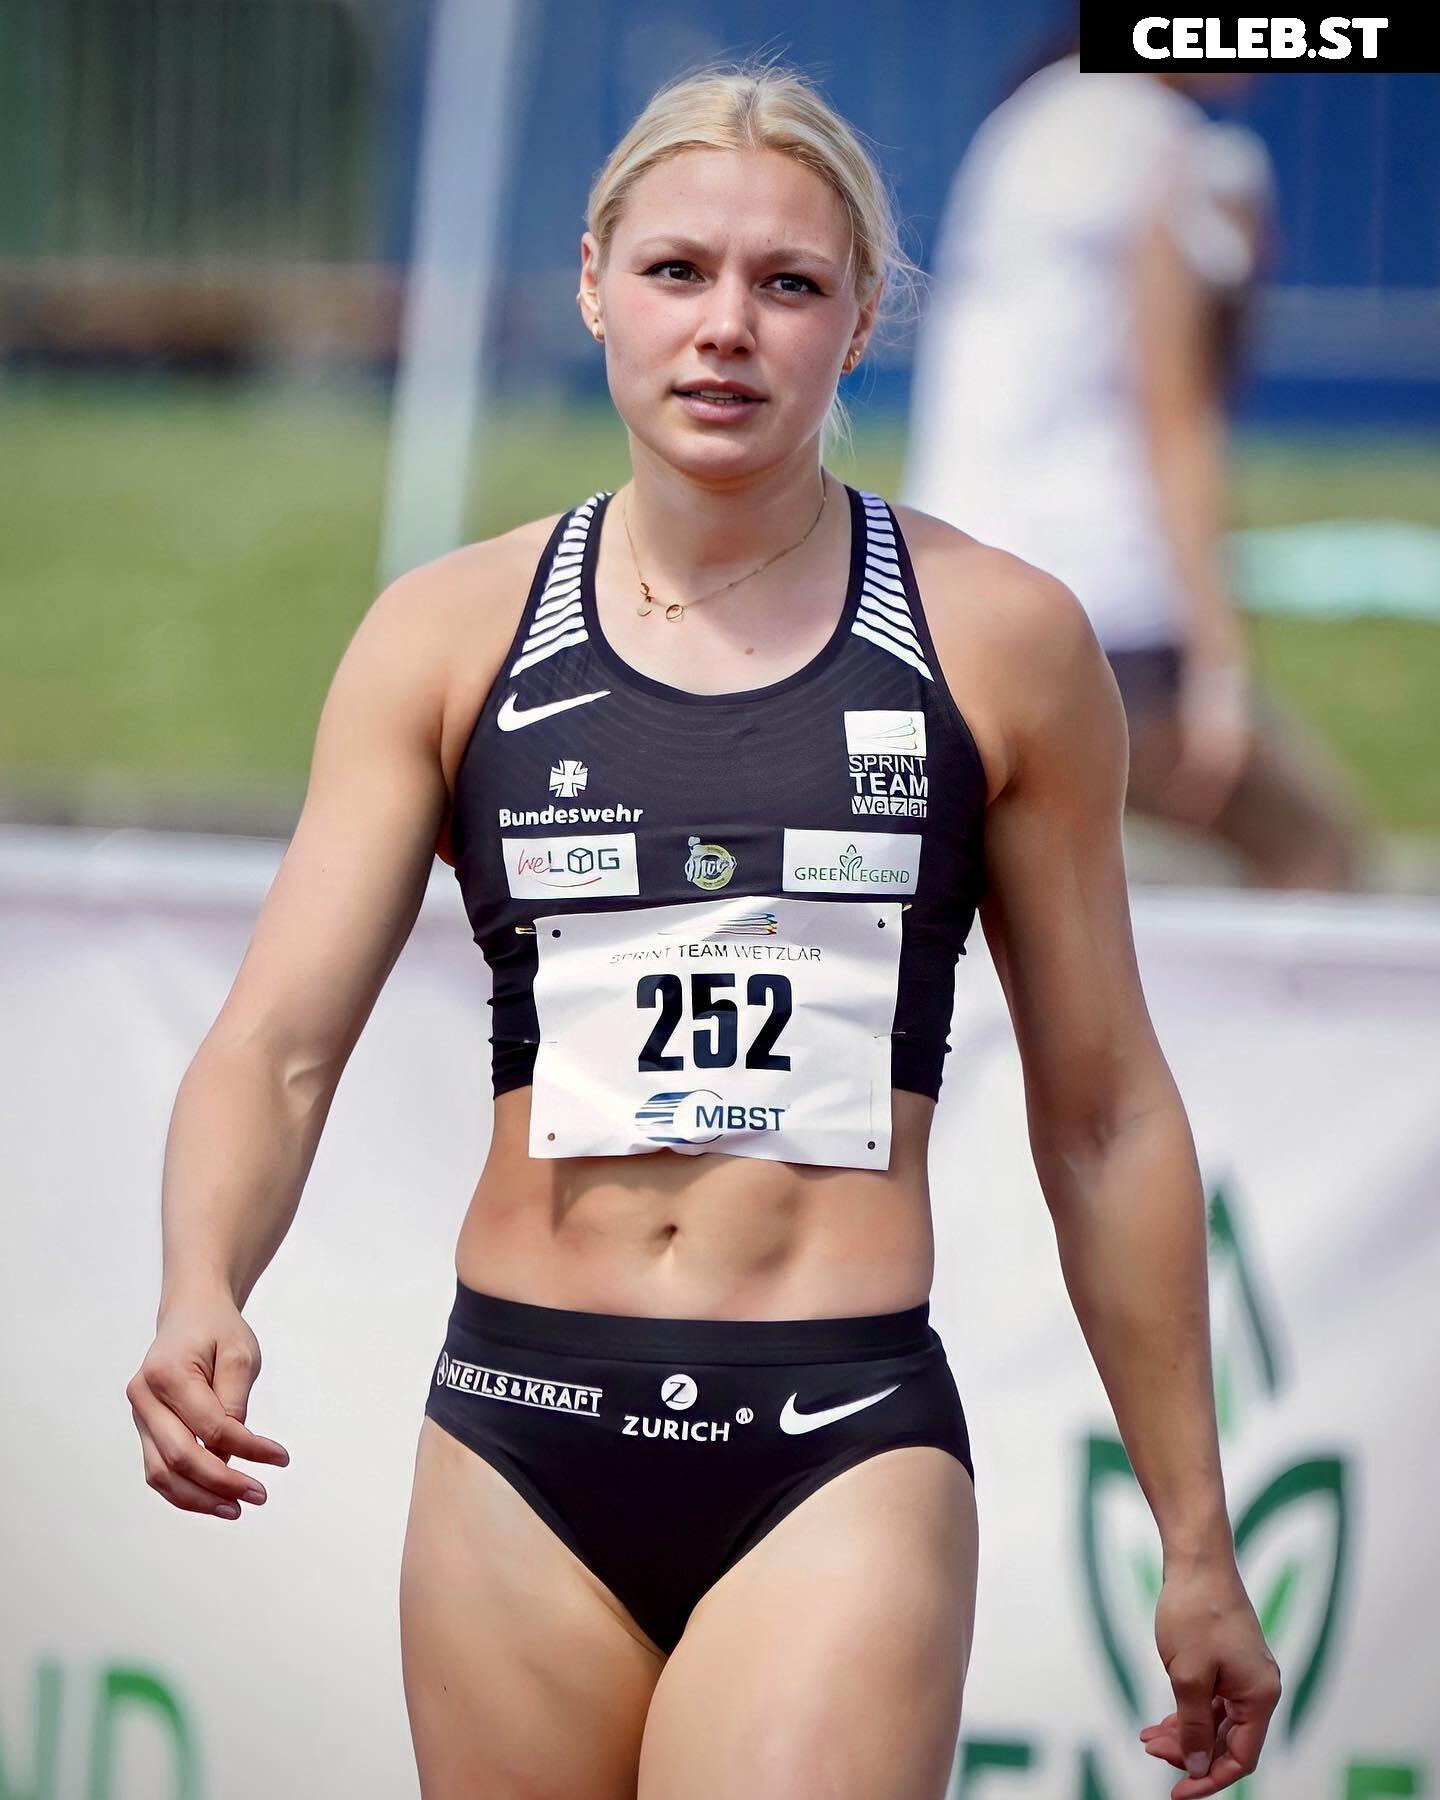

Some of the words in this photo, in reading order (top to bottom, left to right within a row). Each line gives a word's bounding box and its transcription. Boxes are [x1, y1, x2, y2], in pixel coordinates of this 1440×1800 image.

[848, 755, 926, 775] SPRINT
[849, 772, 928, 797] TEAM
[499, 803, 644, 827] Bundeswehr
[610, 947, 671, 964] SPRINT
[678, 944, 729, 959] TEAM
[734, 945, 822, 962] WETZLAR
[635, 973, 793, 1073] 252
[695, 1105, 786, 1131] MBST
[621, 1414, 731, 1442] ZURICH
